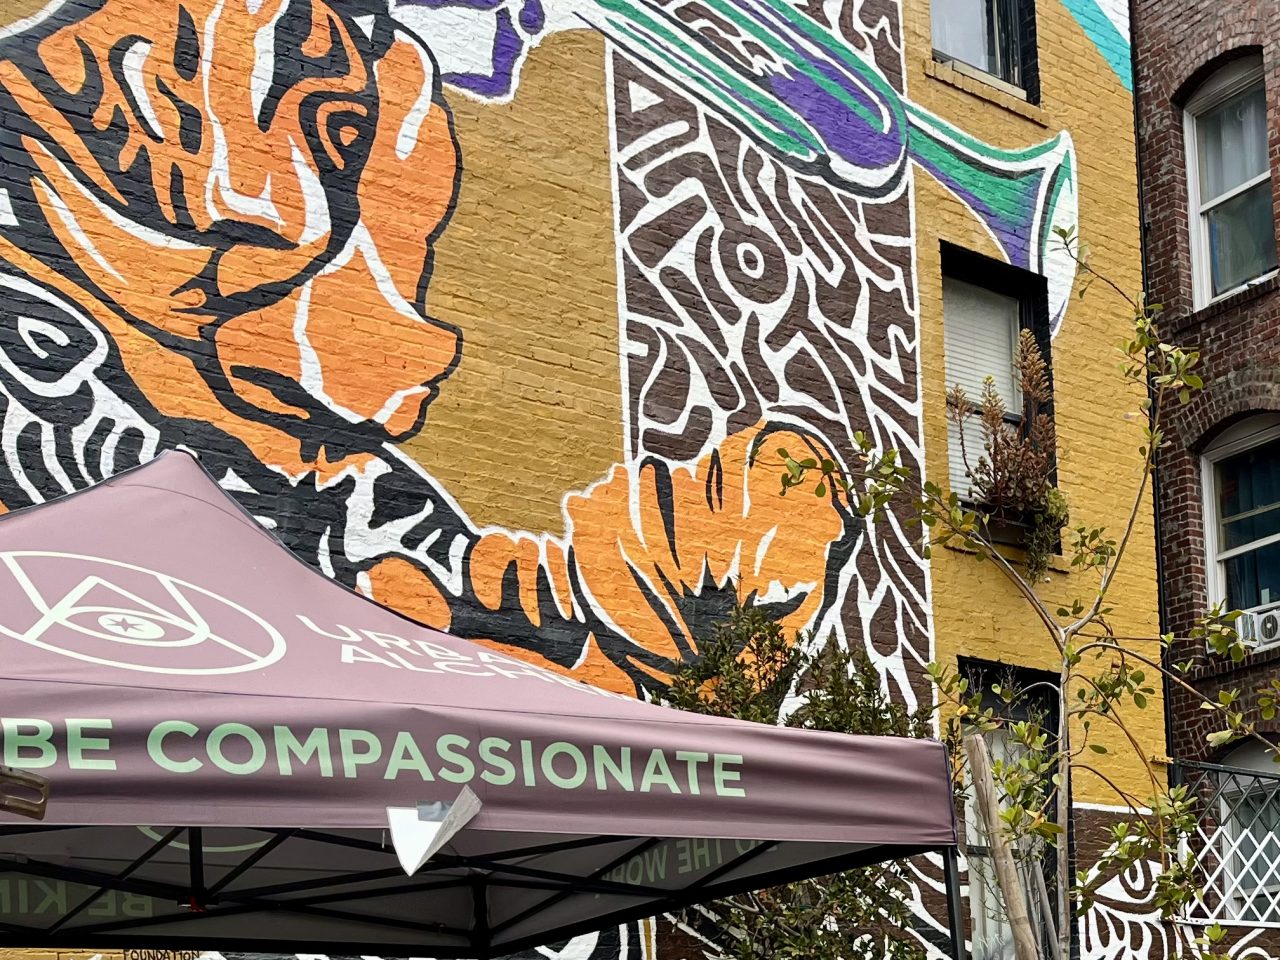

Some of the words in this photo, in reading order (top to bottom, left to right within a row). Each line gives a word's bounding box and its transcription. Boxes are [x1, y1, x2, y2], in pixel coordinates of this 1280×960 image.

[295, 614, 532, 670] URBA
[2, 718, 118, 770] BE
[147, 719, 748, 798] COMPASSIONATE
